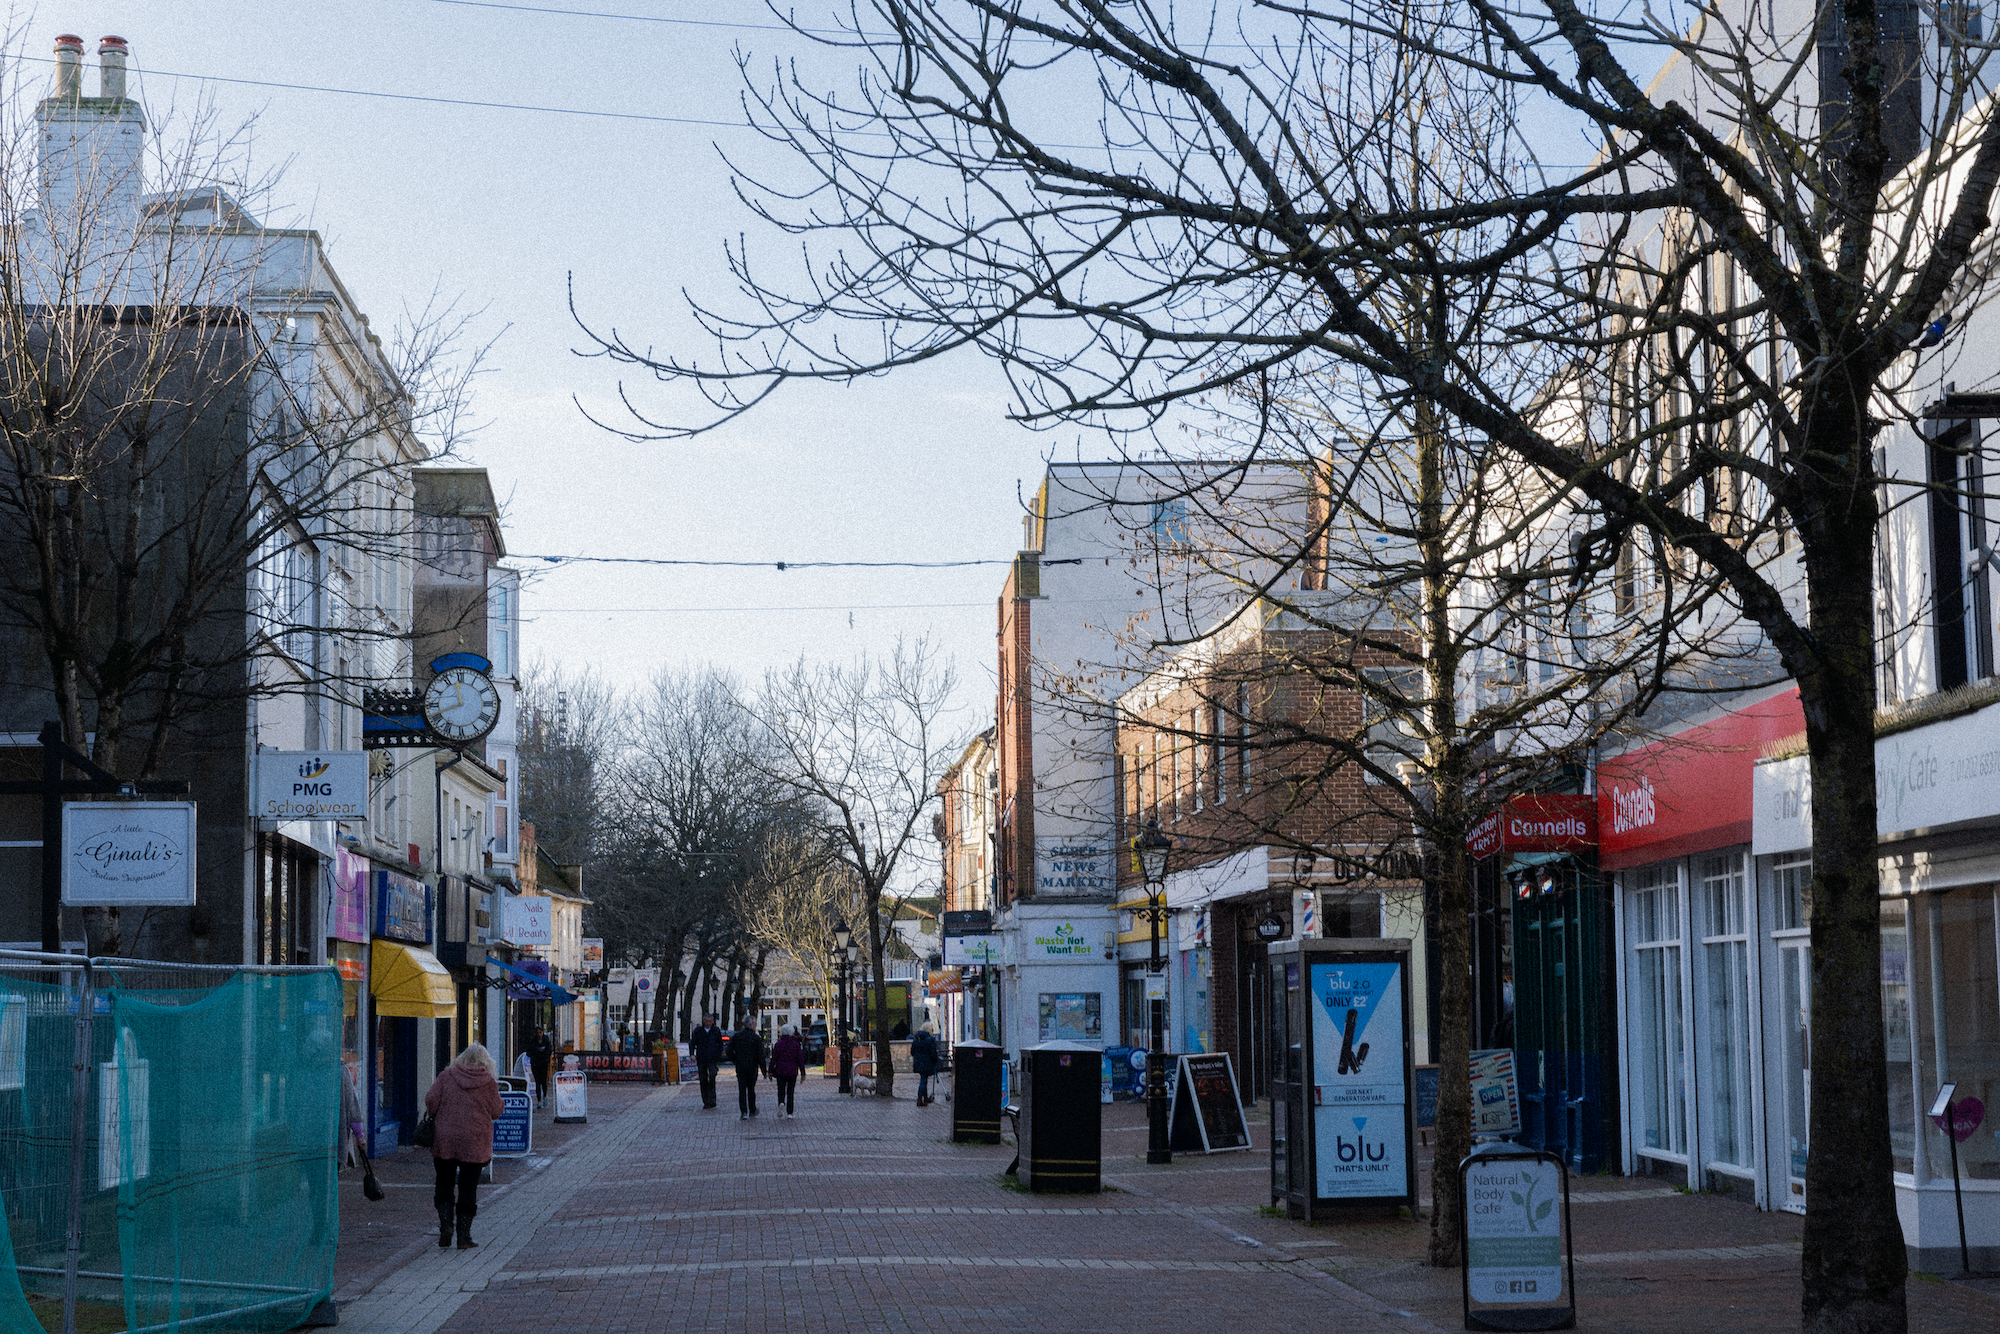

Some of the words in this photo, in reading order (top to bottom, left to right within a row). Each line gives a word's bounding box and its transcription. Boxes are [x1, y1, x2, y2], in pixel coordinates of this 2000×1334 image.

[1908, 744, 1938, 792] Cafe
[293, 783, 332, 796] PMG
[268, 799, 357, 814] Schoolwear
[1613, 776, 1656, 834] Connells
[110, 825, 121, 833] A
[1510, 818, 1587, 836] Connells
[1472, 829, 1497, 851] ARMY
[1051, 861, 1097, 872] NEWS
[90, 868, 119, 881] Italian
[121, 870, 166, 883] Inspiration
[1041, 877, 1106, 888] MARKET
[524, 901, 544, 913] Nails
[518, 926, 549, 941] Beauty
[1035, 937, 1065, 945] Waste
[1067, 936, 1084, 945] Not
[1046, 945, 1072, 954] Want
[1074, 945, 1091, 954] Not
[1330, 978, 1351, 990] blu
[1353, 980, 1371, 990] 2.0
[1326, 996, 1351, 1008] ONLY
[613, 1056, 654, 1069] ROAST
[504, 1098, 525, 1106] PEN
[1481, 1091, 1504, 1102] OPEN
[1337, 1135, 1385, 1162] blu
[1333, 1164, 1364, 1173] THAT'S
[1365, 1164, 1389, 1172] UNLIT
[1473, 1173, 1518, 1186] Natural
[1473, 1188, 1505, 1201] Body
[1473, 1202, 1502, 1214] Cafe
